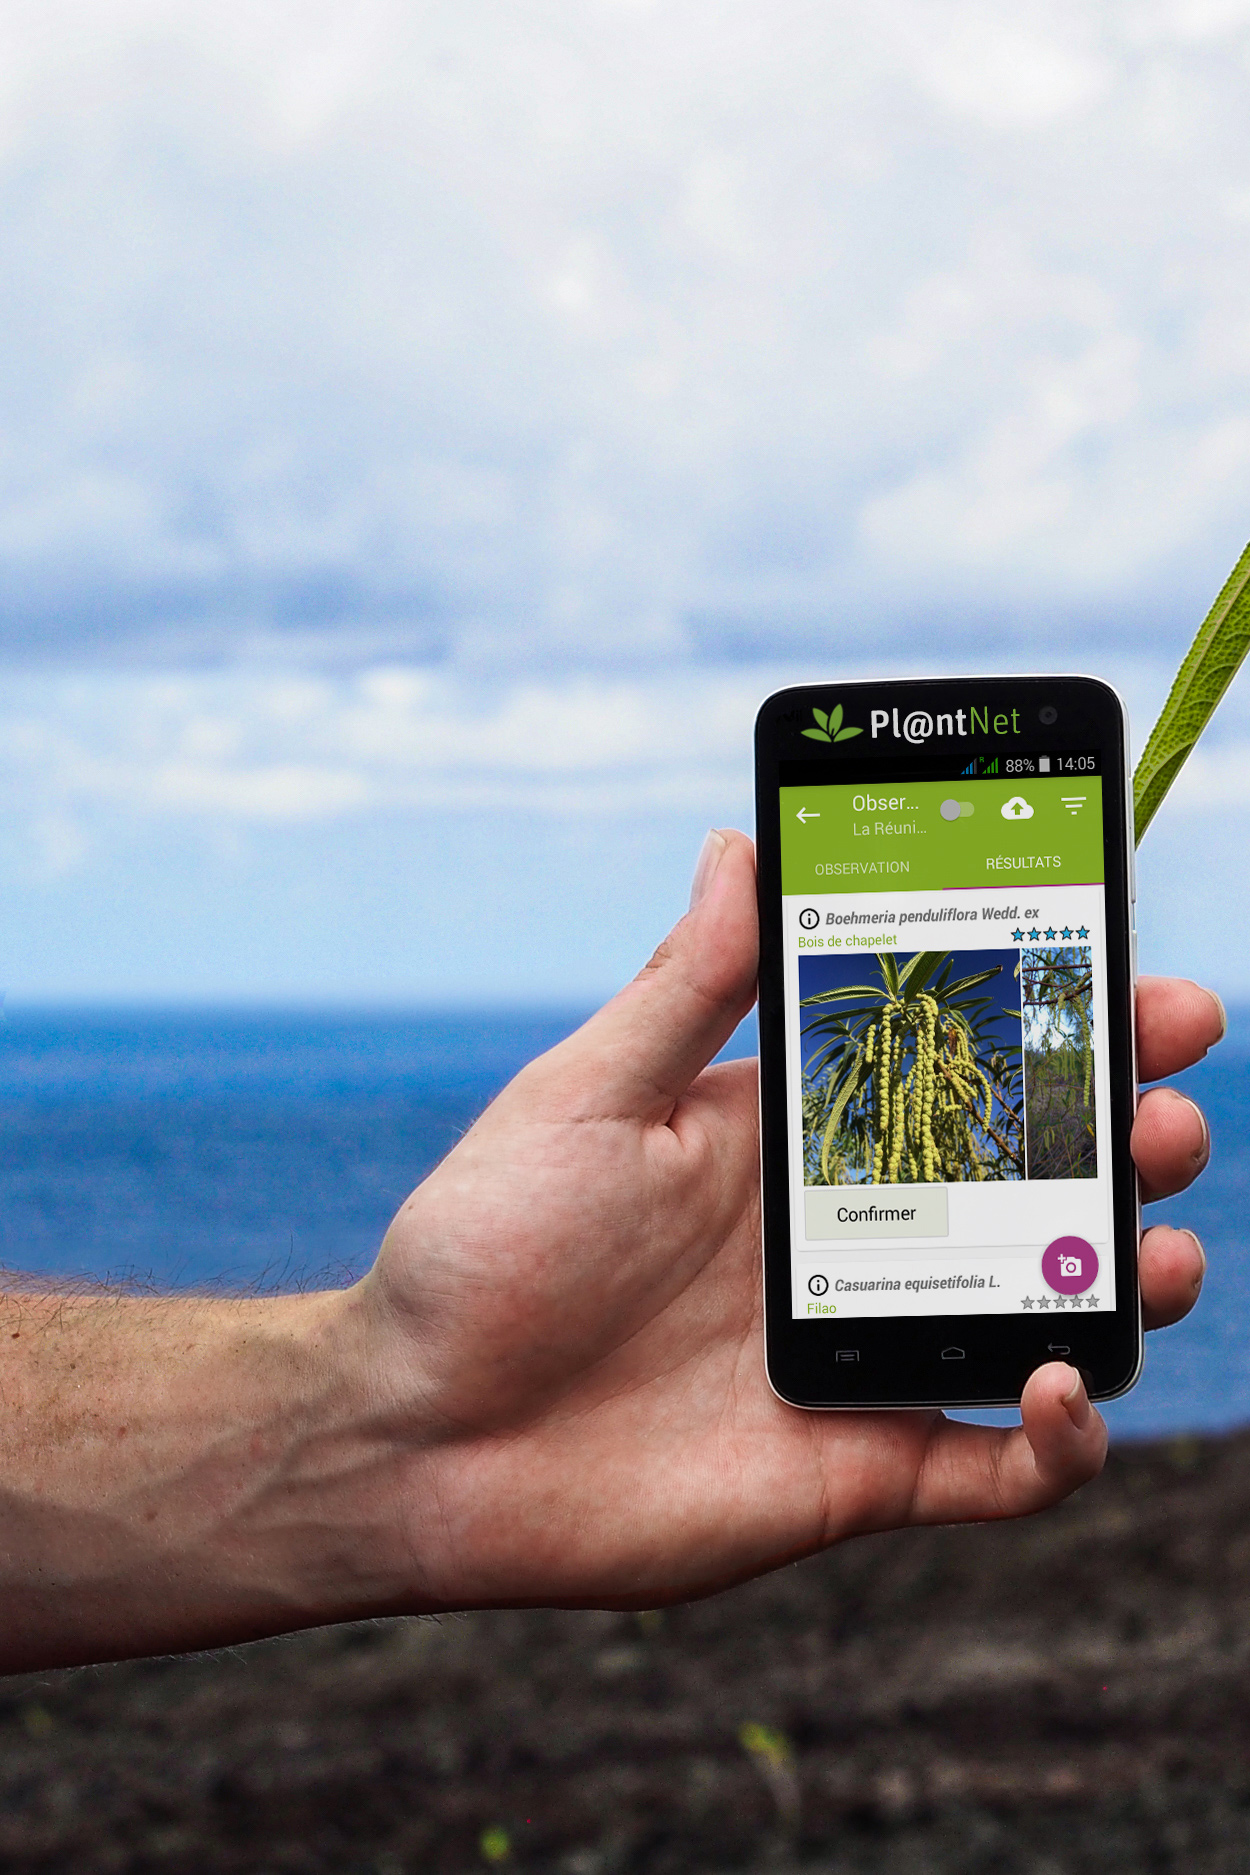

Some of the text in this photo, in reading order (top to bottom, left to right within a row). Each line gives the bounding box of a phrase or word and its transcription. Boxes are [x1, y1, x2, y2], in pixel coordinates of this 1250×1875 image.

[870, 705, 1021, 744] Pl@ntNet
[1005, 758, 1035, 773] 88%
[1056, 756, 1095, 771] 14:05
[853, 822, 870, 836] La
[815, 860, 910, 876] OBSERVATION
[986, 855, 1062, 870] RÉSULTATS
[825, 906, 1040, 926] Boehmeria penduliflora Wedd. ex
[798, 933, 897, 950] Bois de chapelet
[837, 1206, 917, 1223] Confirmer
[834, 1275, 1000, 1294] Casuarina equisetifolia L.
[807, 1302, 837, 1315] Filao
